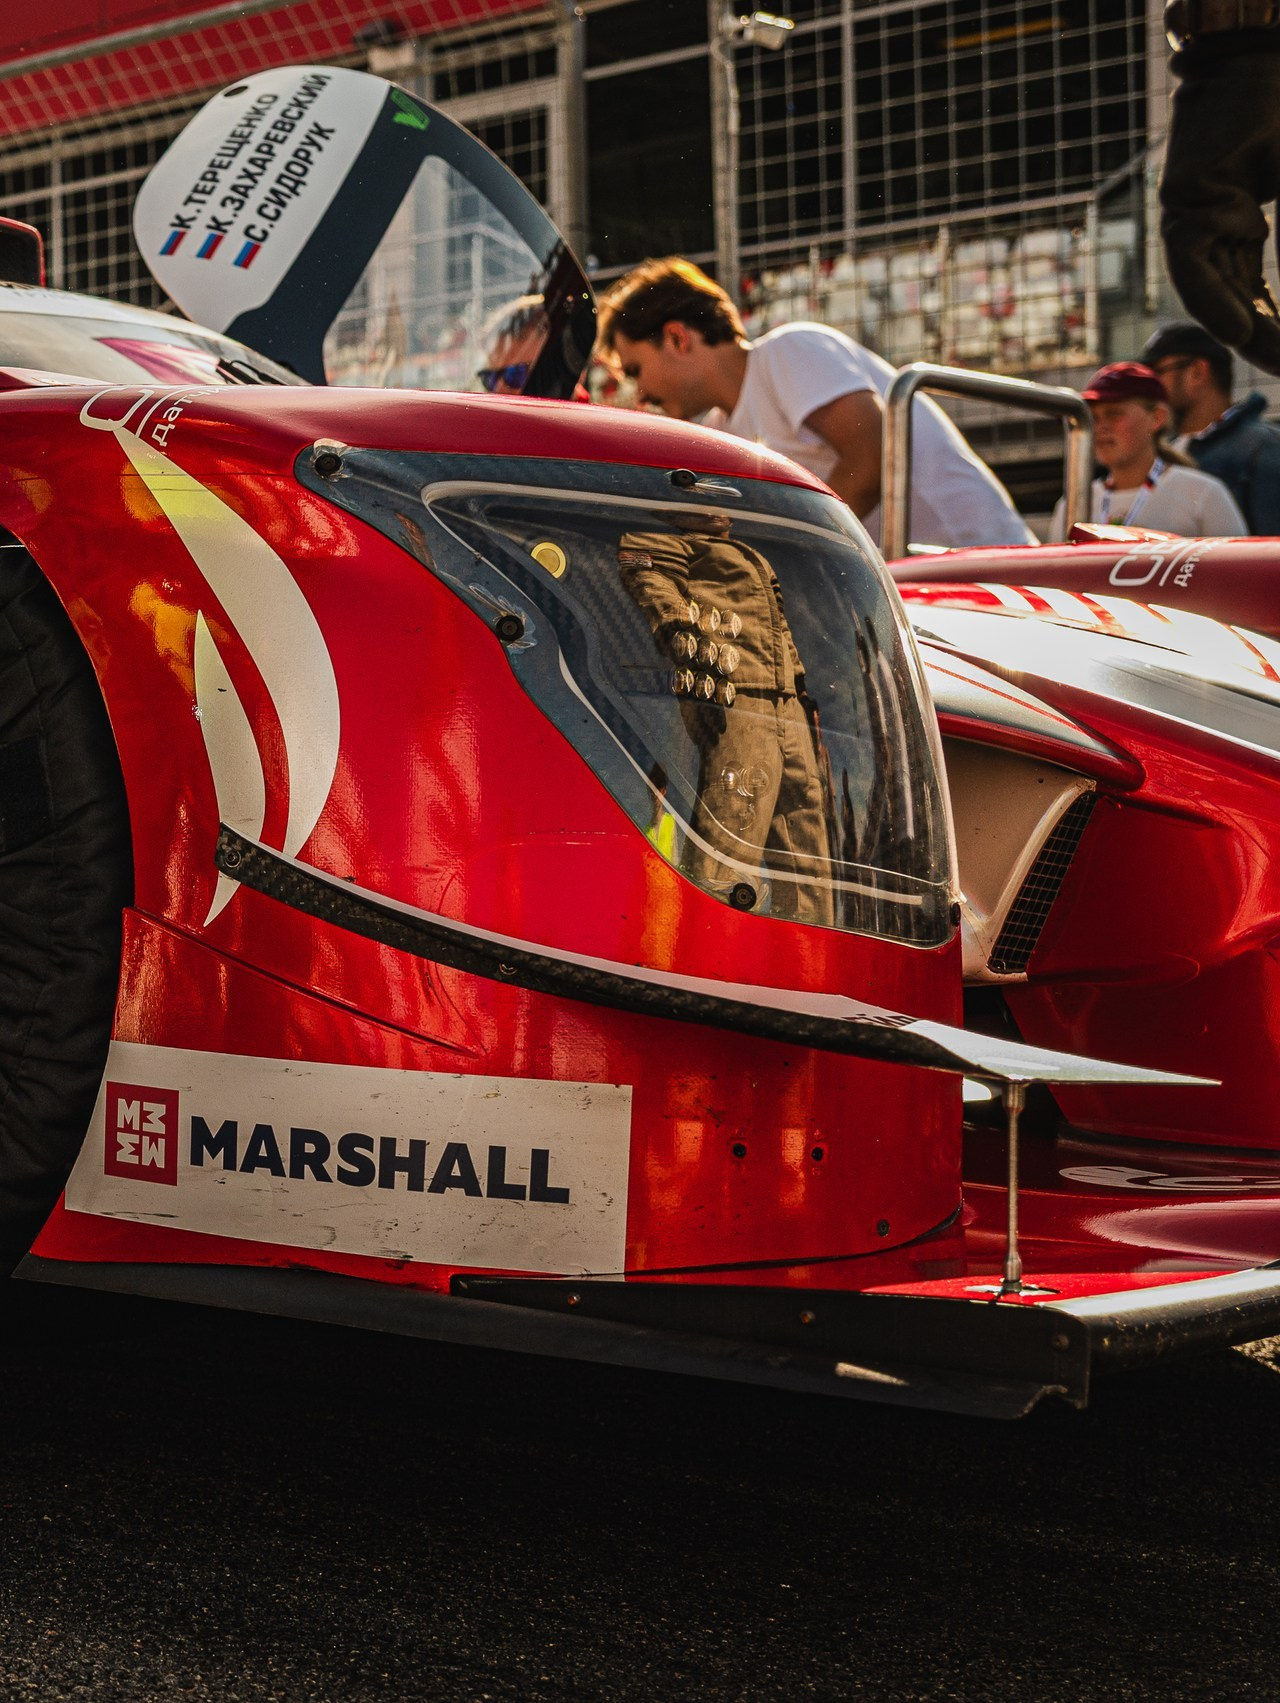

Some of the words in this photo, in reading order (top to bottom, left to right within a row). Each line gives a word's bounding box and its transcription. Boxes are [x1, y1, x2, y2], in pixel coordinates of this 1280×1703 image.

[170, 93, 280, 230] К.ТЕРЕЩЕНКО
[206, 73, 332, 234] К.ЗАХАРЕВСКИЙ
[243, 121, 336, 244] С.СИДОРУК
[190, 1115, 570, 1204] MARSHALL
